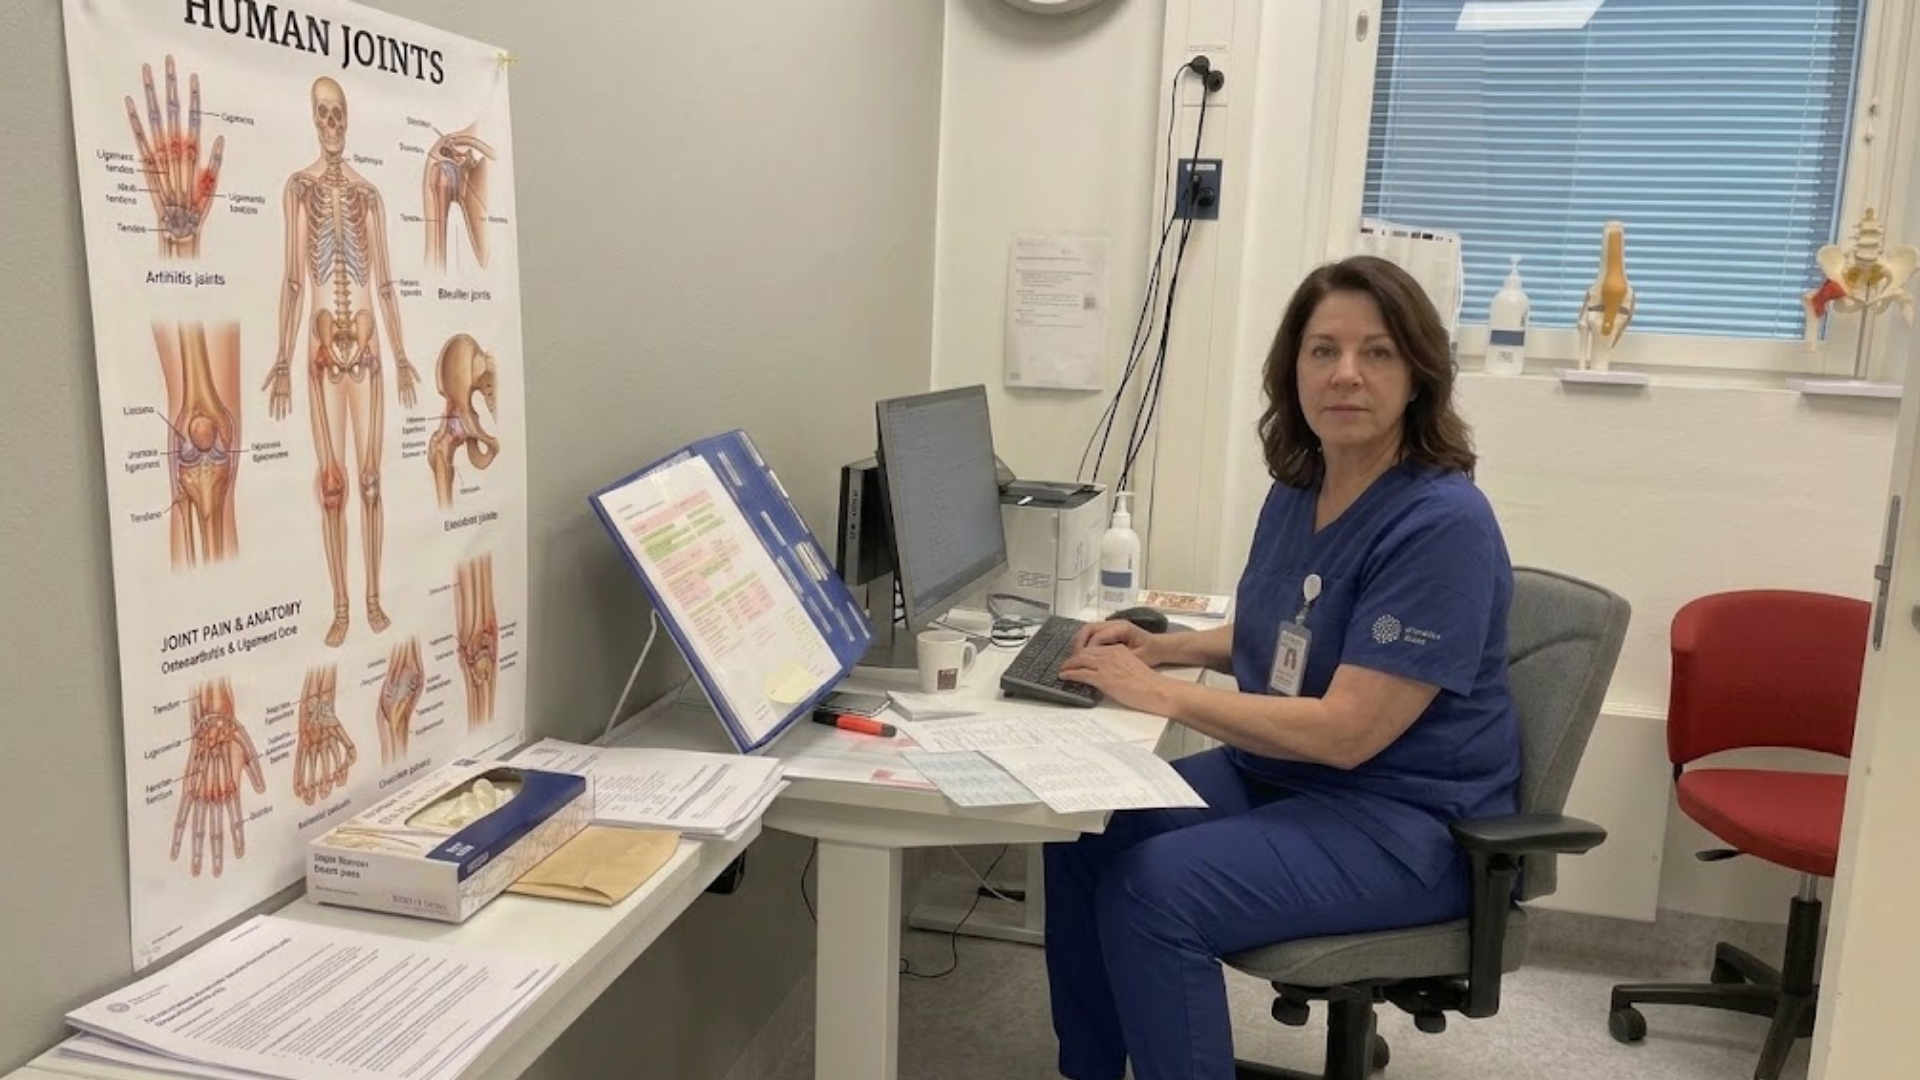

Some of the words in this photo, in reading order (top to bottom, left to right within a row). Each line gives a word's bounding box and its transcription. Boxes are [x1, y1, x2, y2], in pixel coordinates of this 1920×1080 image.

[184, 0, 330, 56] HUMAN
[341, 24, 444, 85] JOINTS
[160, 628, 199, 653] JOINT
[203, 620, 232, 642] PAIN
[235, 616, 244, 632] &
[246, 599, 303, 628] ANATOMY
[228, 641, 235, 655] &
